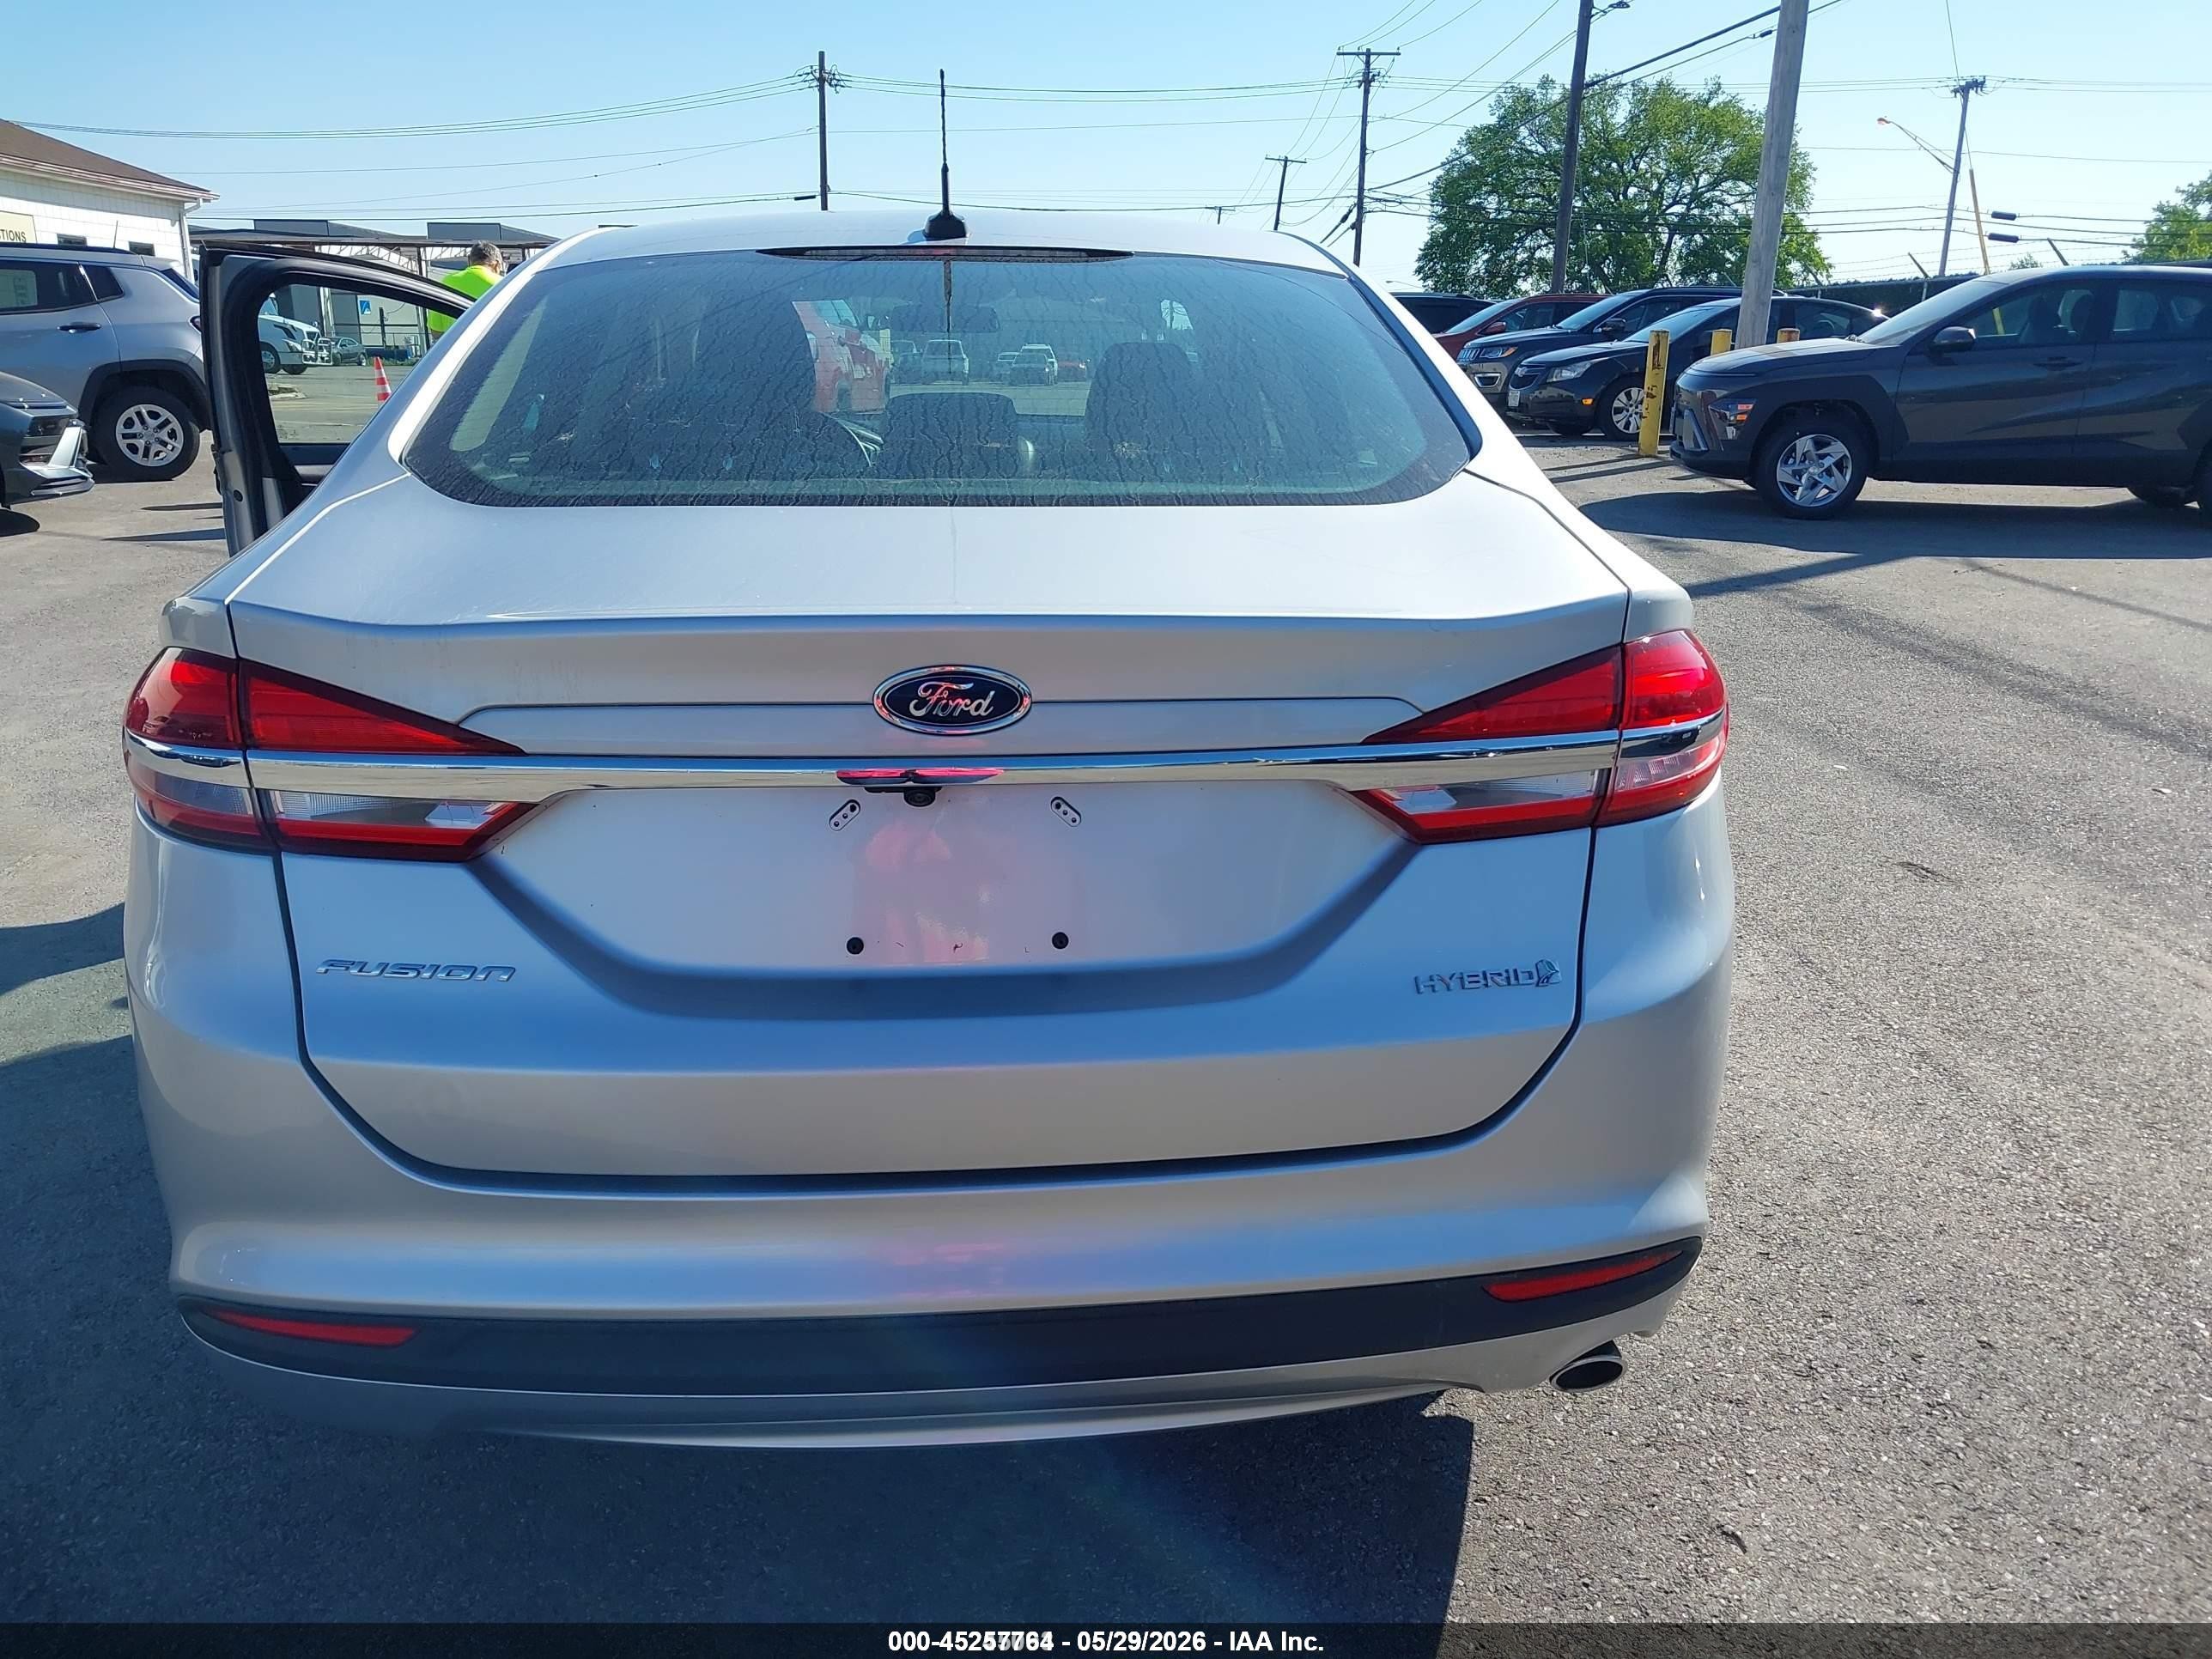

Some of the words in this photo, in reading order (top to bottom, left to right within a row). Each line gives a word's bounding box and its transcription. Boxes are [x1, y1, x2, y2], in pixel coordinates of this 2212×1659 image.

[0, 228, 27, 243] TIONS
[908, 681, 996, 717] Ford
[316, 959, 516, 982] FUSION
[1413, 968, 1534, 995] HYBRID
